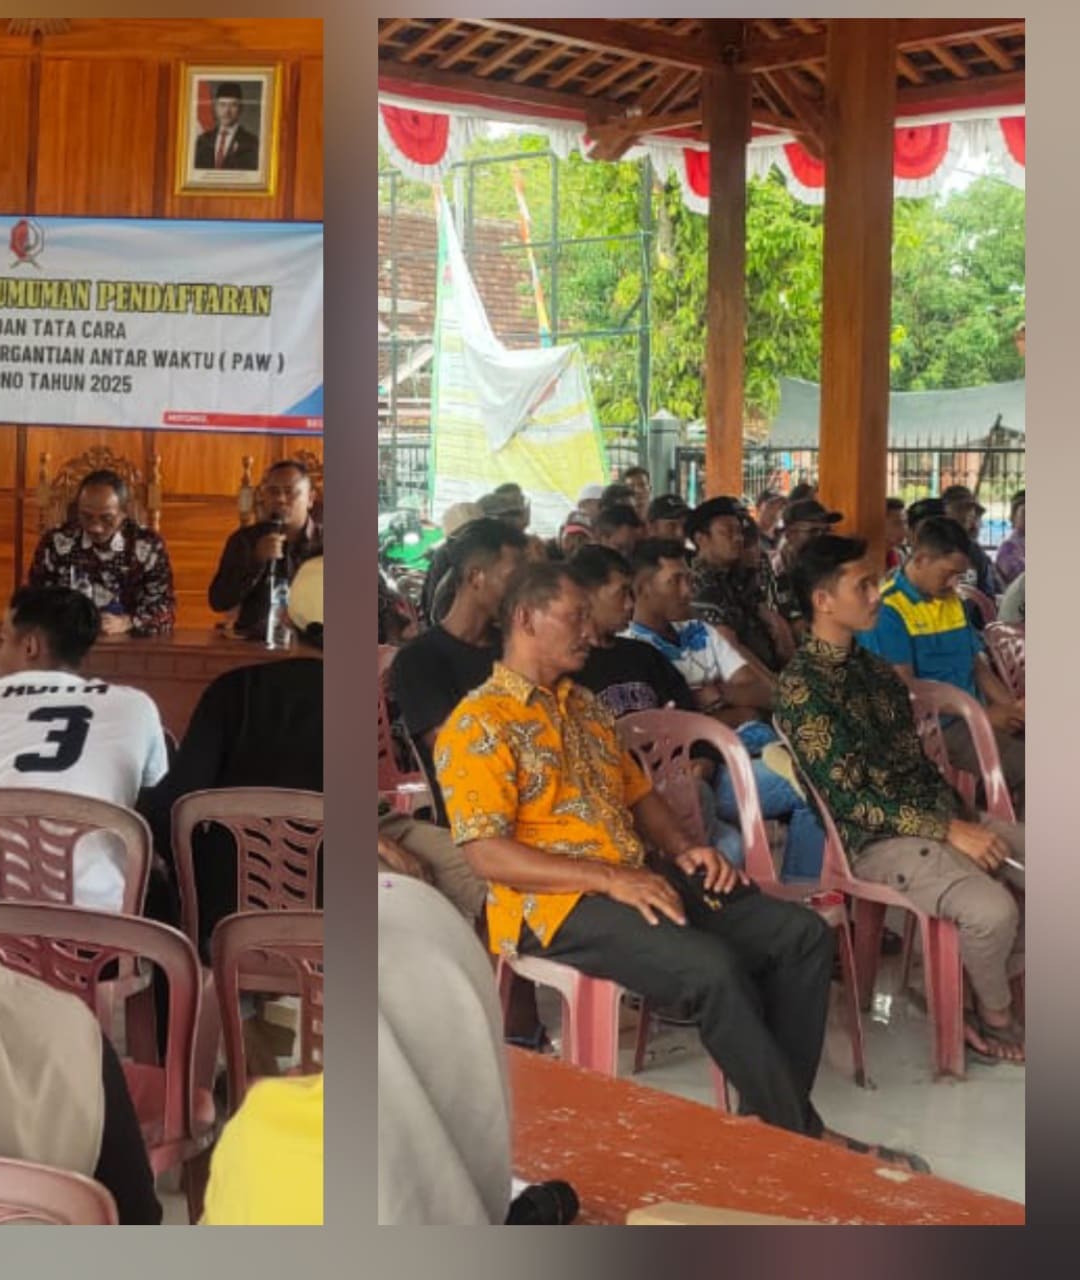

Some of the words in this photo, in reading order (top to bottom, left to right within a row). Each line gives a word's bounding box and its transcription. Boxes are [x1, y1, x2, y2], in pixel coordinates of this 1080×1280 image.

[96, 280, 272, 316] PENDAFTARAN
[33, 319, 76, 337] TATA
[82, 320, 126, 339] CARA
[89, 348, 147, 368] ANTAR
[153, 349, 214, 369] WAKTU
[232, 352, 272, 371] PAW
[29, 372, 85, 391] TAHUN
[91, 375, 132, 393] 2025
[13, 705, 94, 773] 3
